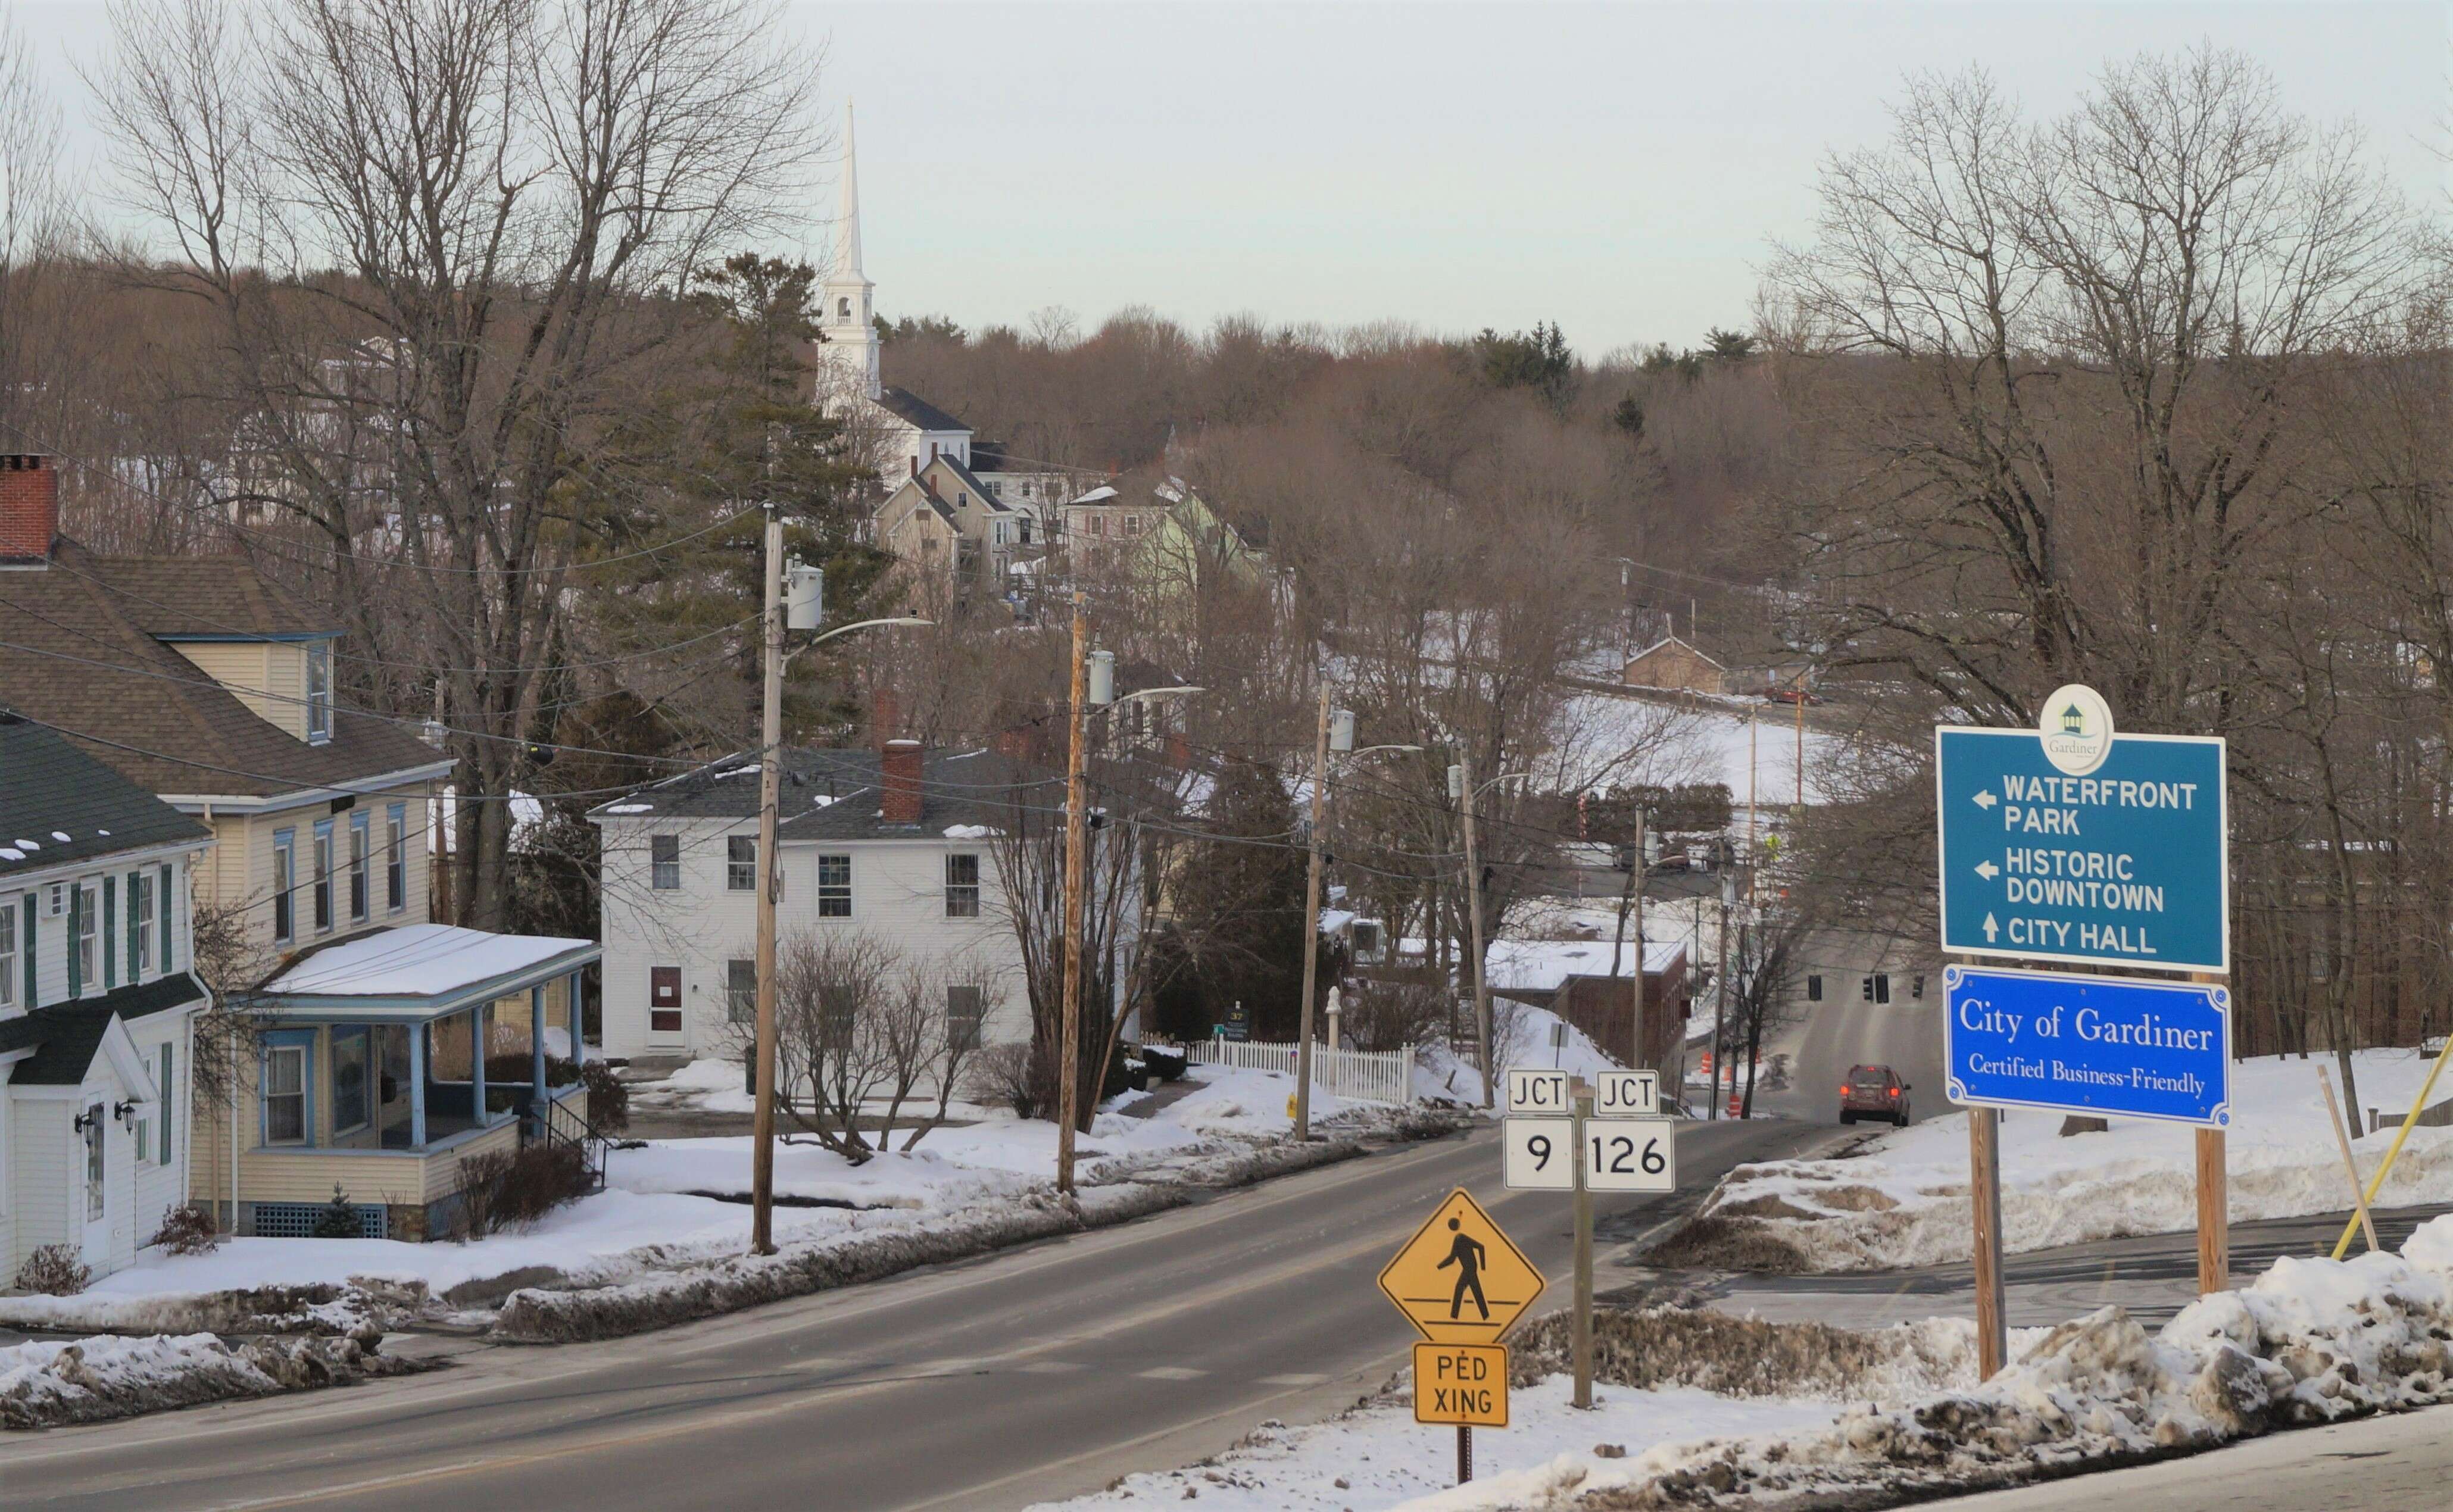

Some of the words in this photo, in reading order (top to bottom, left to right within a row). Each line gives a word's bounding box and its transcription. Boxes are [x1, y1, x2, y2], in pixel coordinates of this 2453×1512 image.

[2049, 739, 2098, 754] Gardiner
[2002, 774, 2198, 810] WATERFRONT
[2004, 805, 2081, 836] PARK
[2006, 846, 2134, 881] HISTORIC
[2006, 877, 2164, 912] DOWNTOWN
[2008, 917, 2072, 947] CITY
[2080, 923, 2158, 954] HALL
[1959, 998, 2023, 1044] City
[2035, 1006, 2064, 1038] of
[2075, 1007, 2214, 1051] Gardiner
[1513, 1077, 1563, 1105] JCT
[1603, 1078, 1653, 1107] JCT
[1968, 1052, 2045, 1079] Certified
[2052, 1060, 2206, 1099] Business-Friendly
[1527, 1135, 1552, 1172] 9
[1591, 1136, 1666, 1175] 126
[1437, 1355, 1487, 1382] PED
[1434, 1388, 1492, 1414] XING
